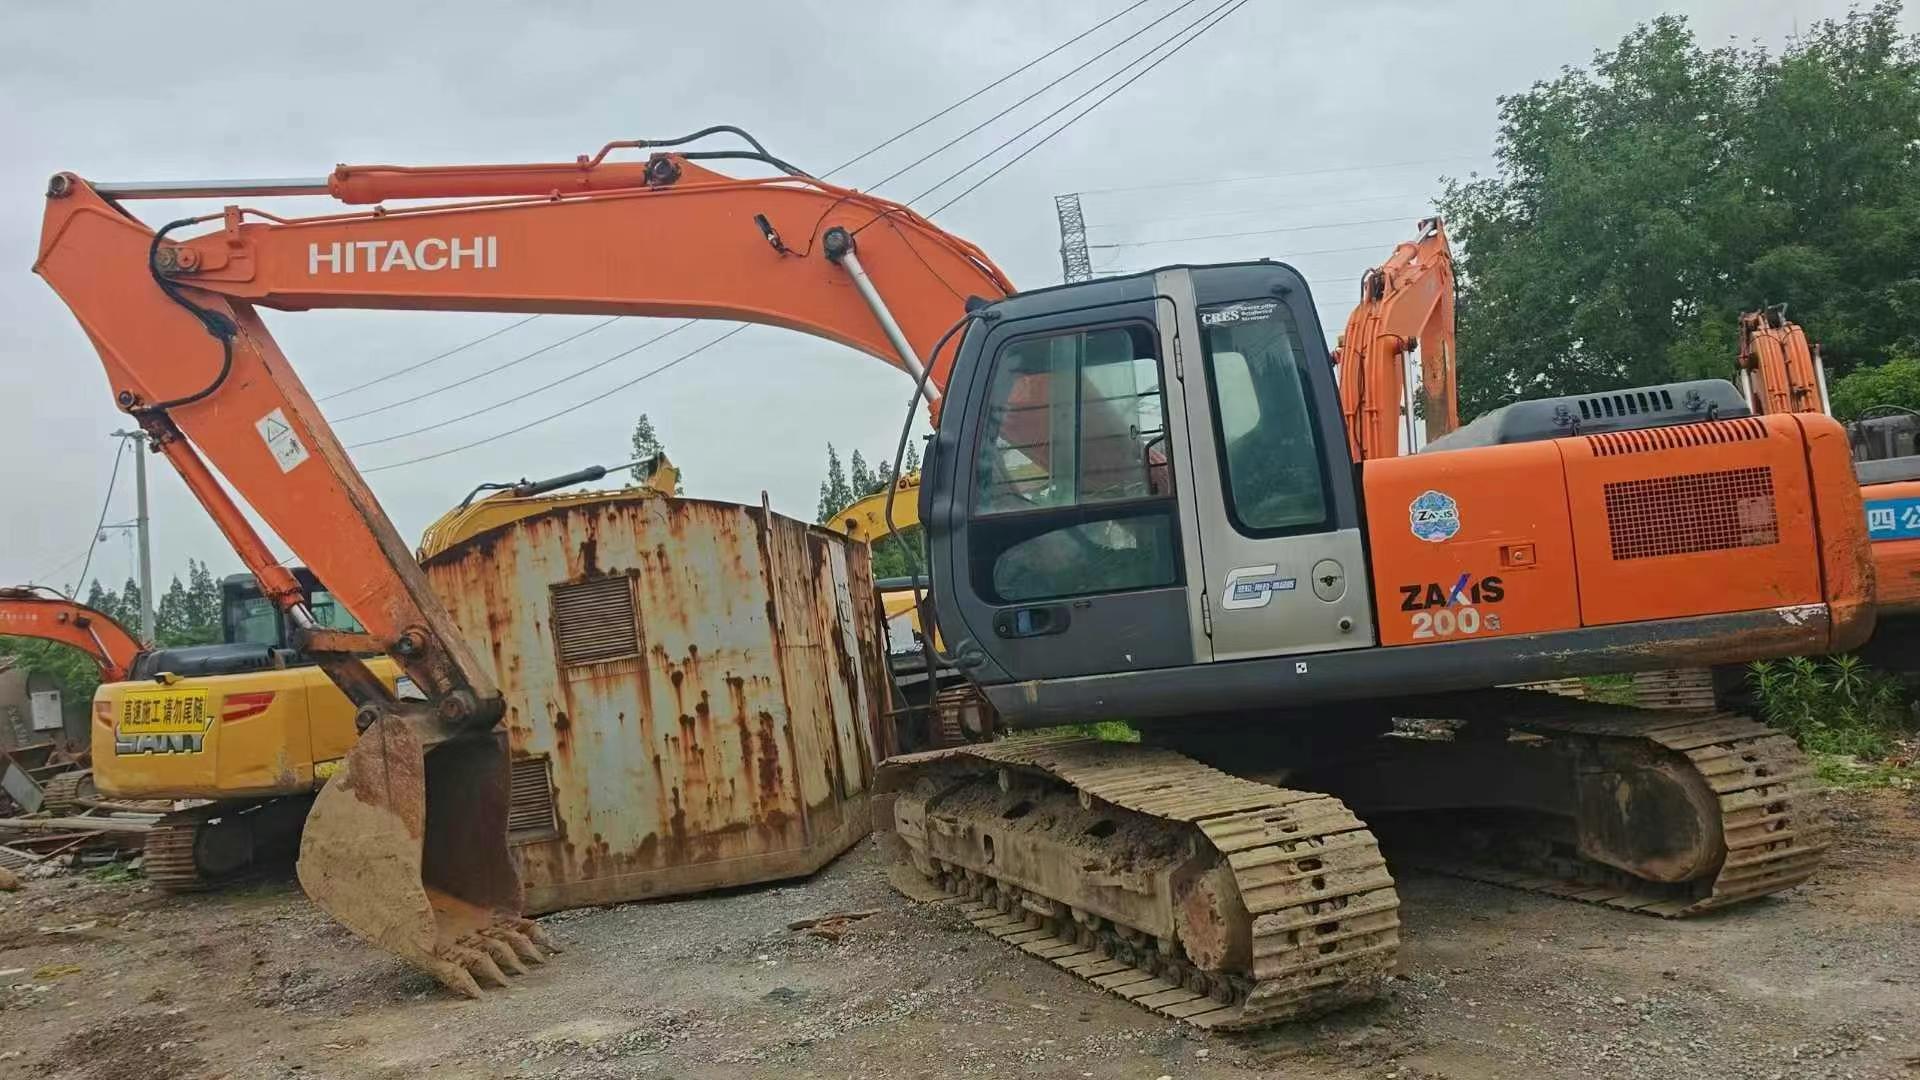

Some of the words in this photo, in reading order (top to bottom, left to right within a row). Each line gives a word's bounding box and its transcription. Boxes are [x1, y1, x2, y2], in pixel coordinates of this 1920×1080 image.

[309, 236, 497, 275] HITACHI
[1200, 310, 1240, 325] CRES
[1400, 573, 1504, 611] ZAXIS
